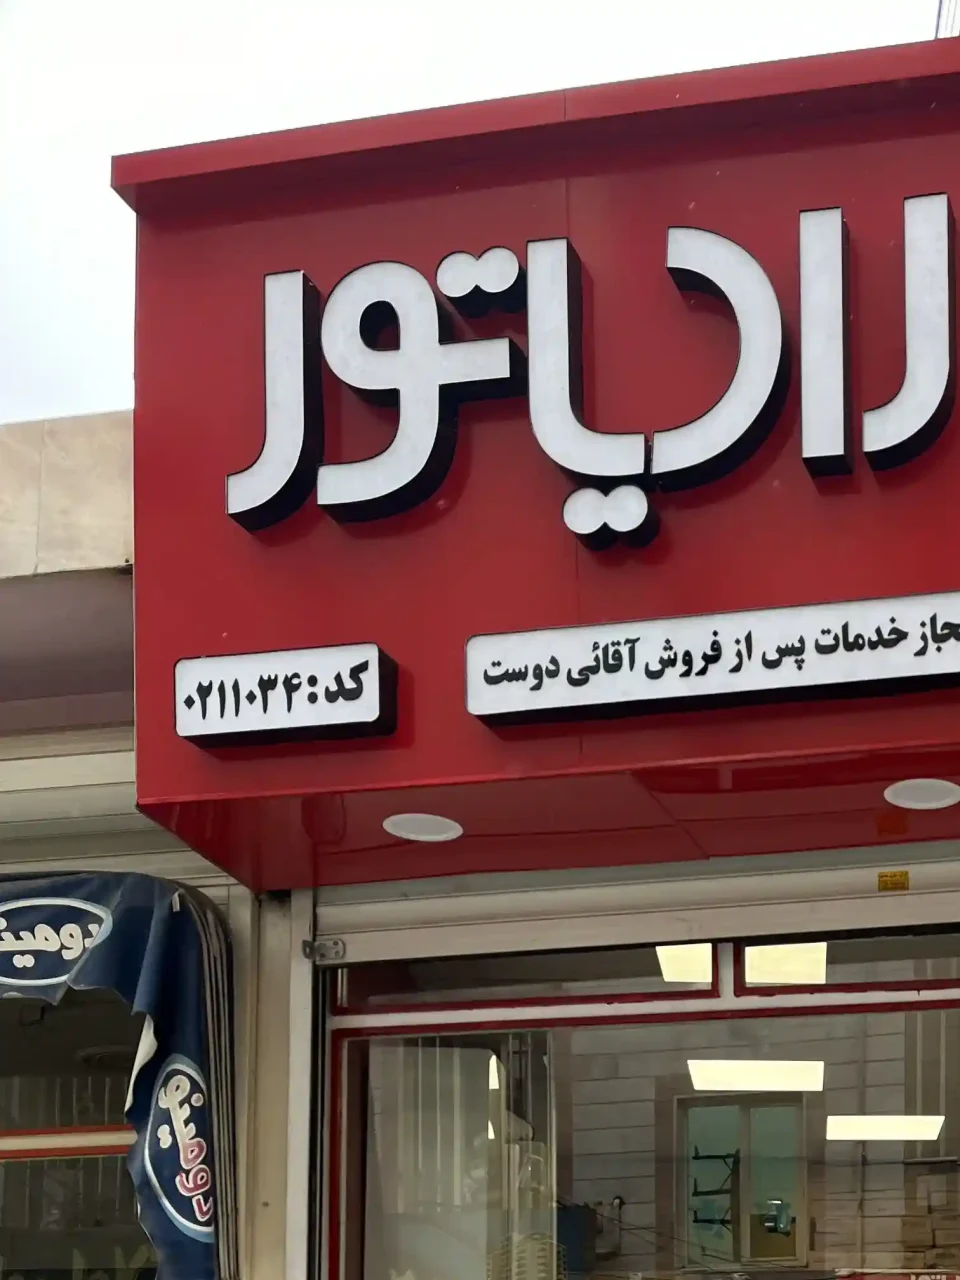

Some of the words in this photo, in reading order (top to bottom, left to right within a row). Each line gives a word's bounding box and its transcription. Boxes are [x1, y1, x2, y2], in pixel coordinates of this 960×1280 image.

[226, 193, 949, 536] رادیاتور
[644, 629, 723, 680] فروش
[728, 630, 752, 674] از
[761, 633, 806, 671] پس
[814, 616, 909, 655] خدمات
[483, 655, 561, 691] دوست
[566, 636, 641, 687] آقائی
[0, 916, 100, 968] دومین
